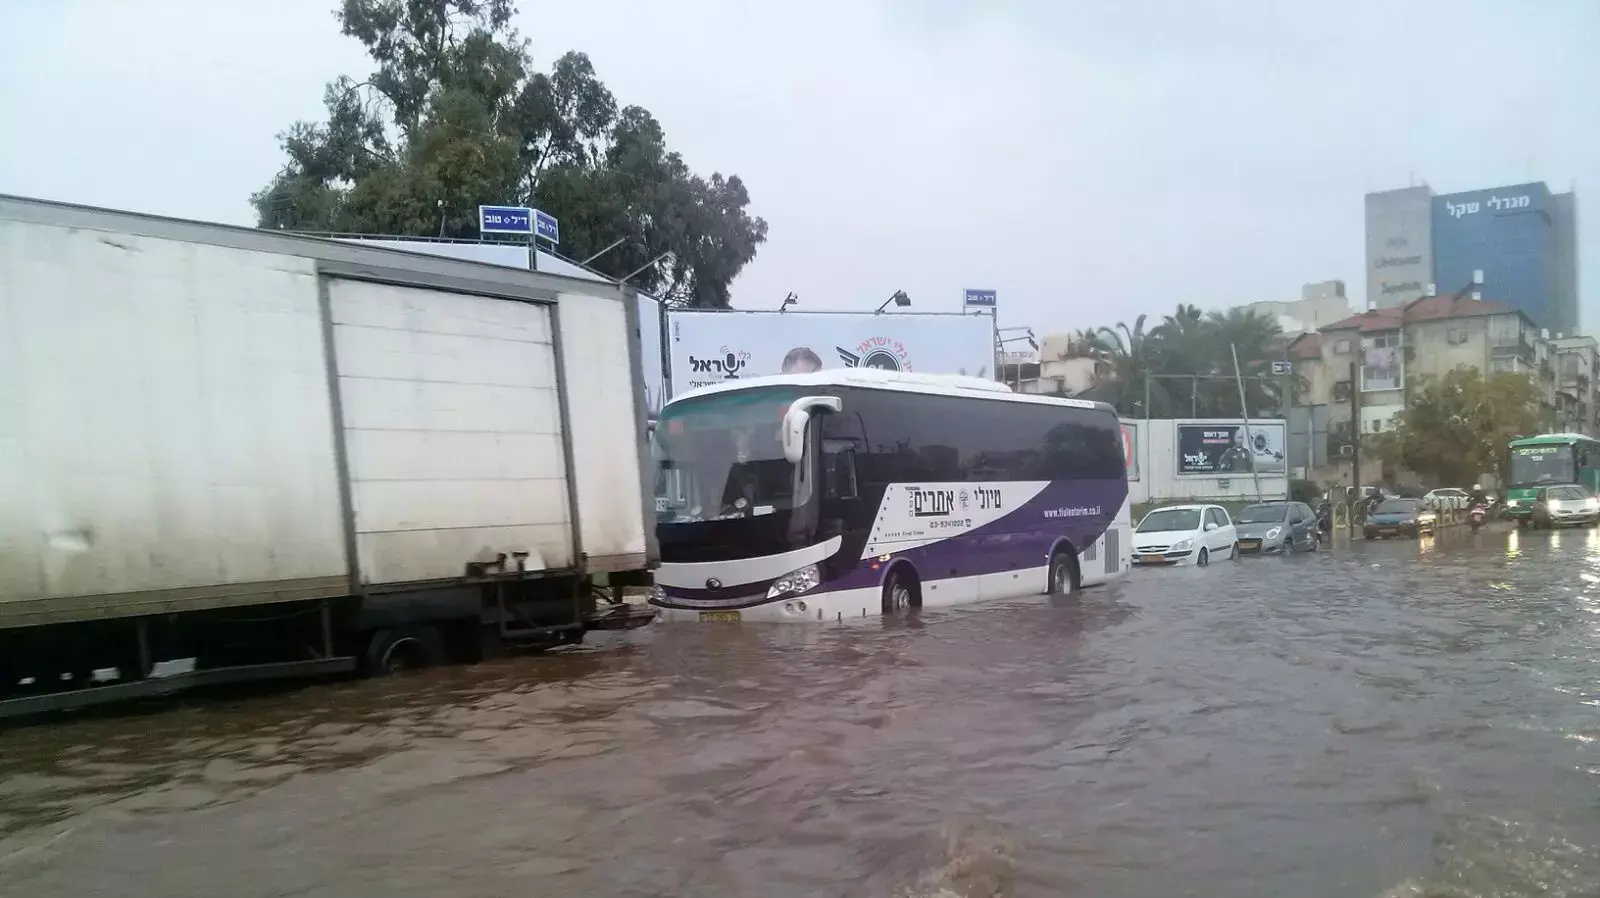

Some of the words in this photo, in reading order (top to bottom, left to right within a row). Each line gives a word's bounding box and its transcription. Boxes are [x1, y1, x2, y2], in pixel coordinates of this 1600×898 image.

[1446, 200, 1480, 219] שקל
[1487, 195, 1530, 210] מגדלי
[484, 215, 502, 224] טוב
[511, 215, 528, 225] דיל
[856, 336, 891, 354] ישראל
[738, 350, 752, 360] גלי
[689, 353, 746, 379] ישראל
[914, 490, 954, 517] אתרים
[974, 486, 1002, 509] טיולי
